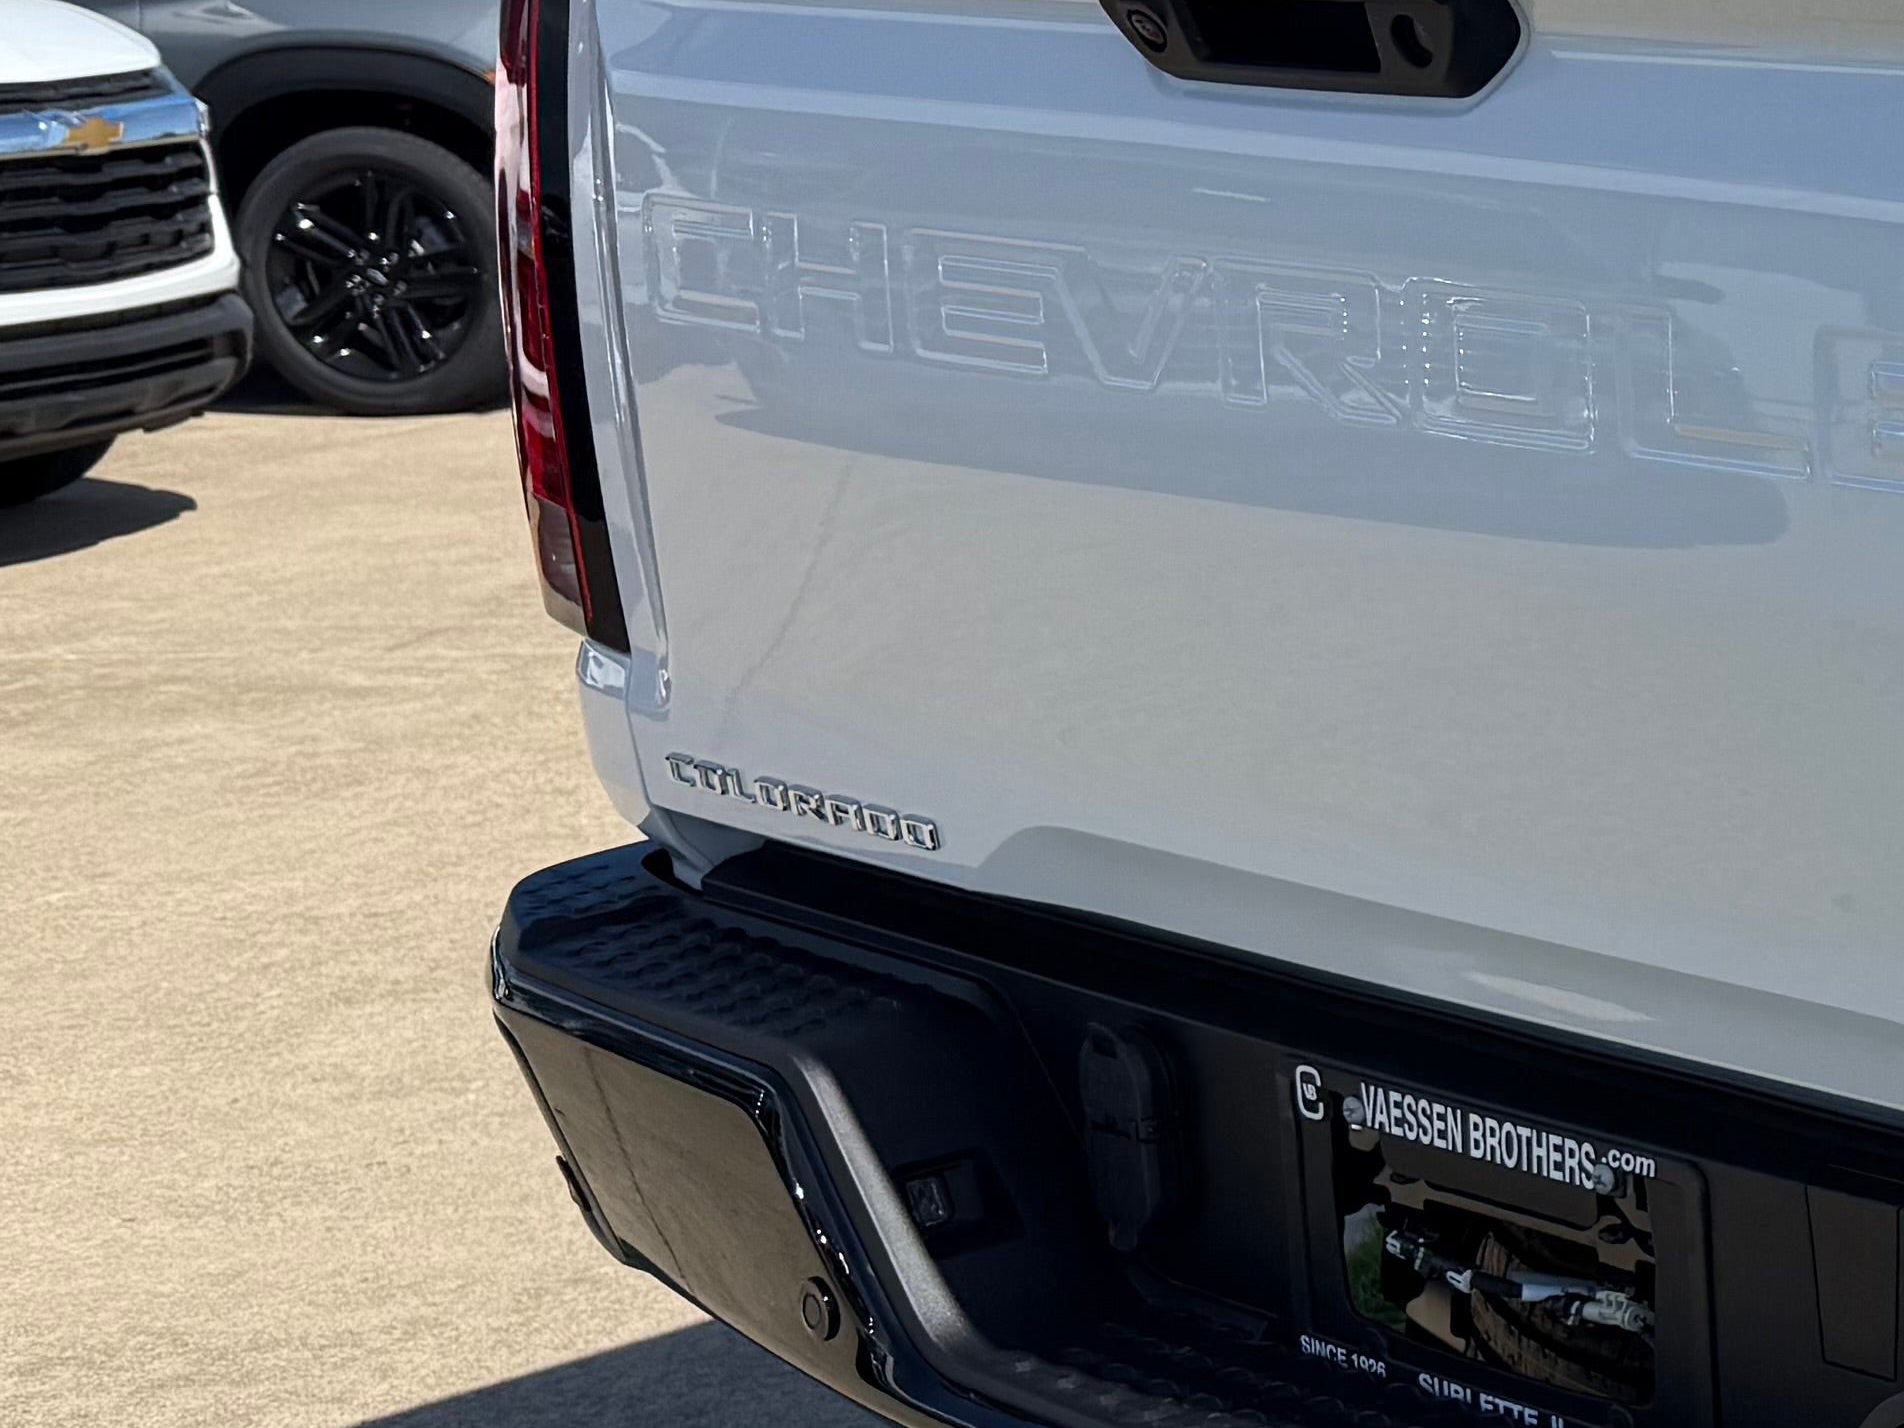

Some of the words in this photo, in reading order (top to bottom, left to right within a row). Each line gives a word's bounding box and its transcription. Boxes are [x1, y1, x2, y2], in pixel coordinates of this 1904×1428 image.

[664, 751, 942, 851] COLORADO
[1360, 1082, 1463, 1153] VAESSEN
[1469, 1113, 1596, 1190] BROTHERS
[1300, 1334, 1349, 1369] SINCE
